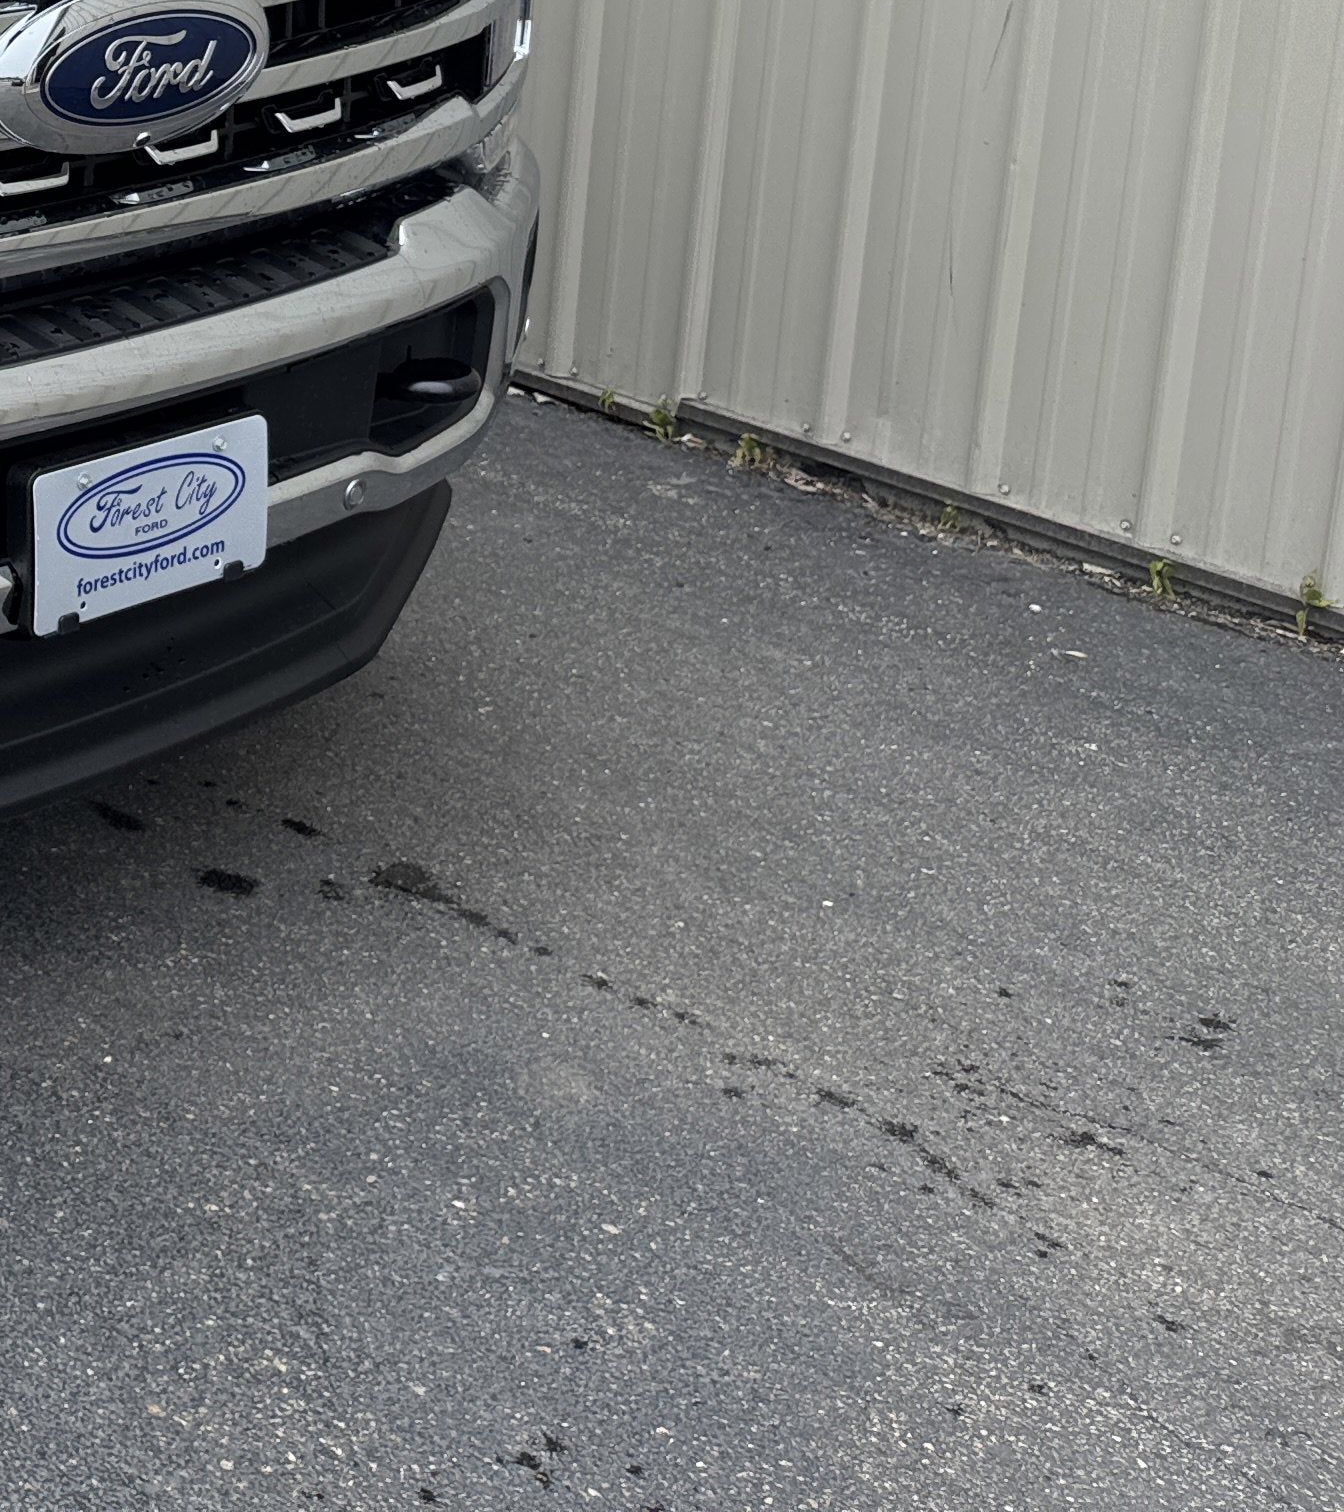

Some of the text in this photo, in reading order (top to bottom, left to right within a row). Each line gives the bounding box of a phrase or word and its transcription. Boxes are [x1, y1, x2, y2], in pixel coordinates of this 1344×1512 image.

[90, 29, 217, 107] Ford
[90, 471, 217, 533] Forest City
[135, 519, 168, 537] FORD
[76, 540, 226, 597] forestcityford.com
